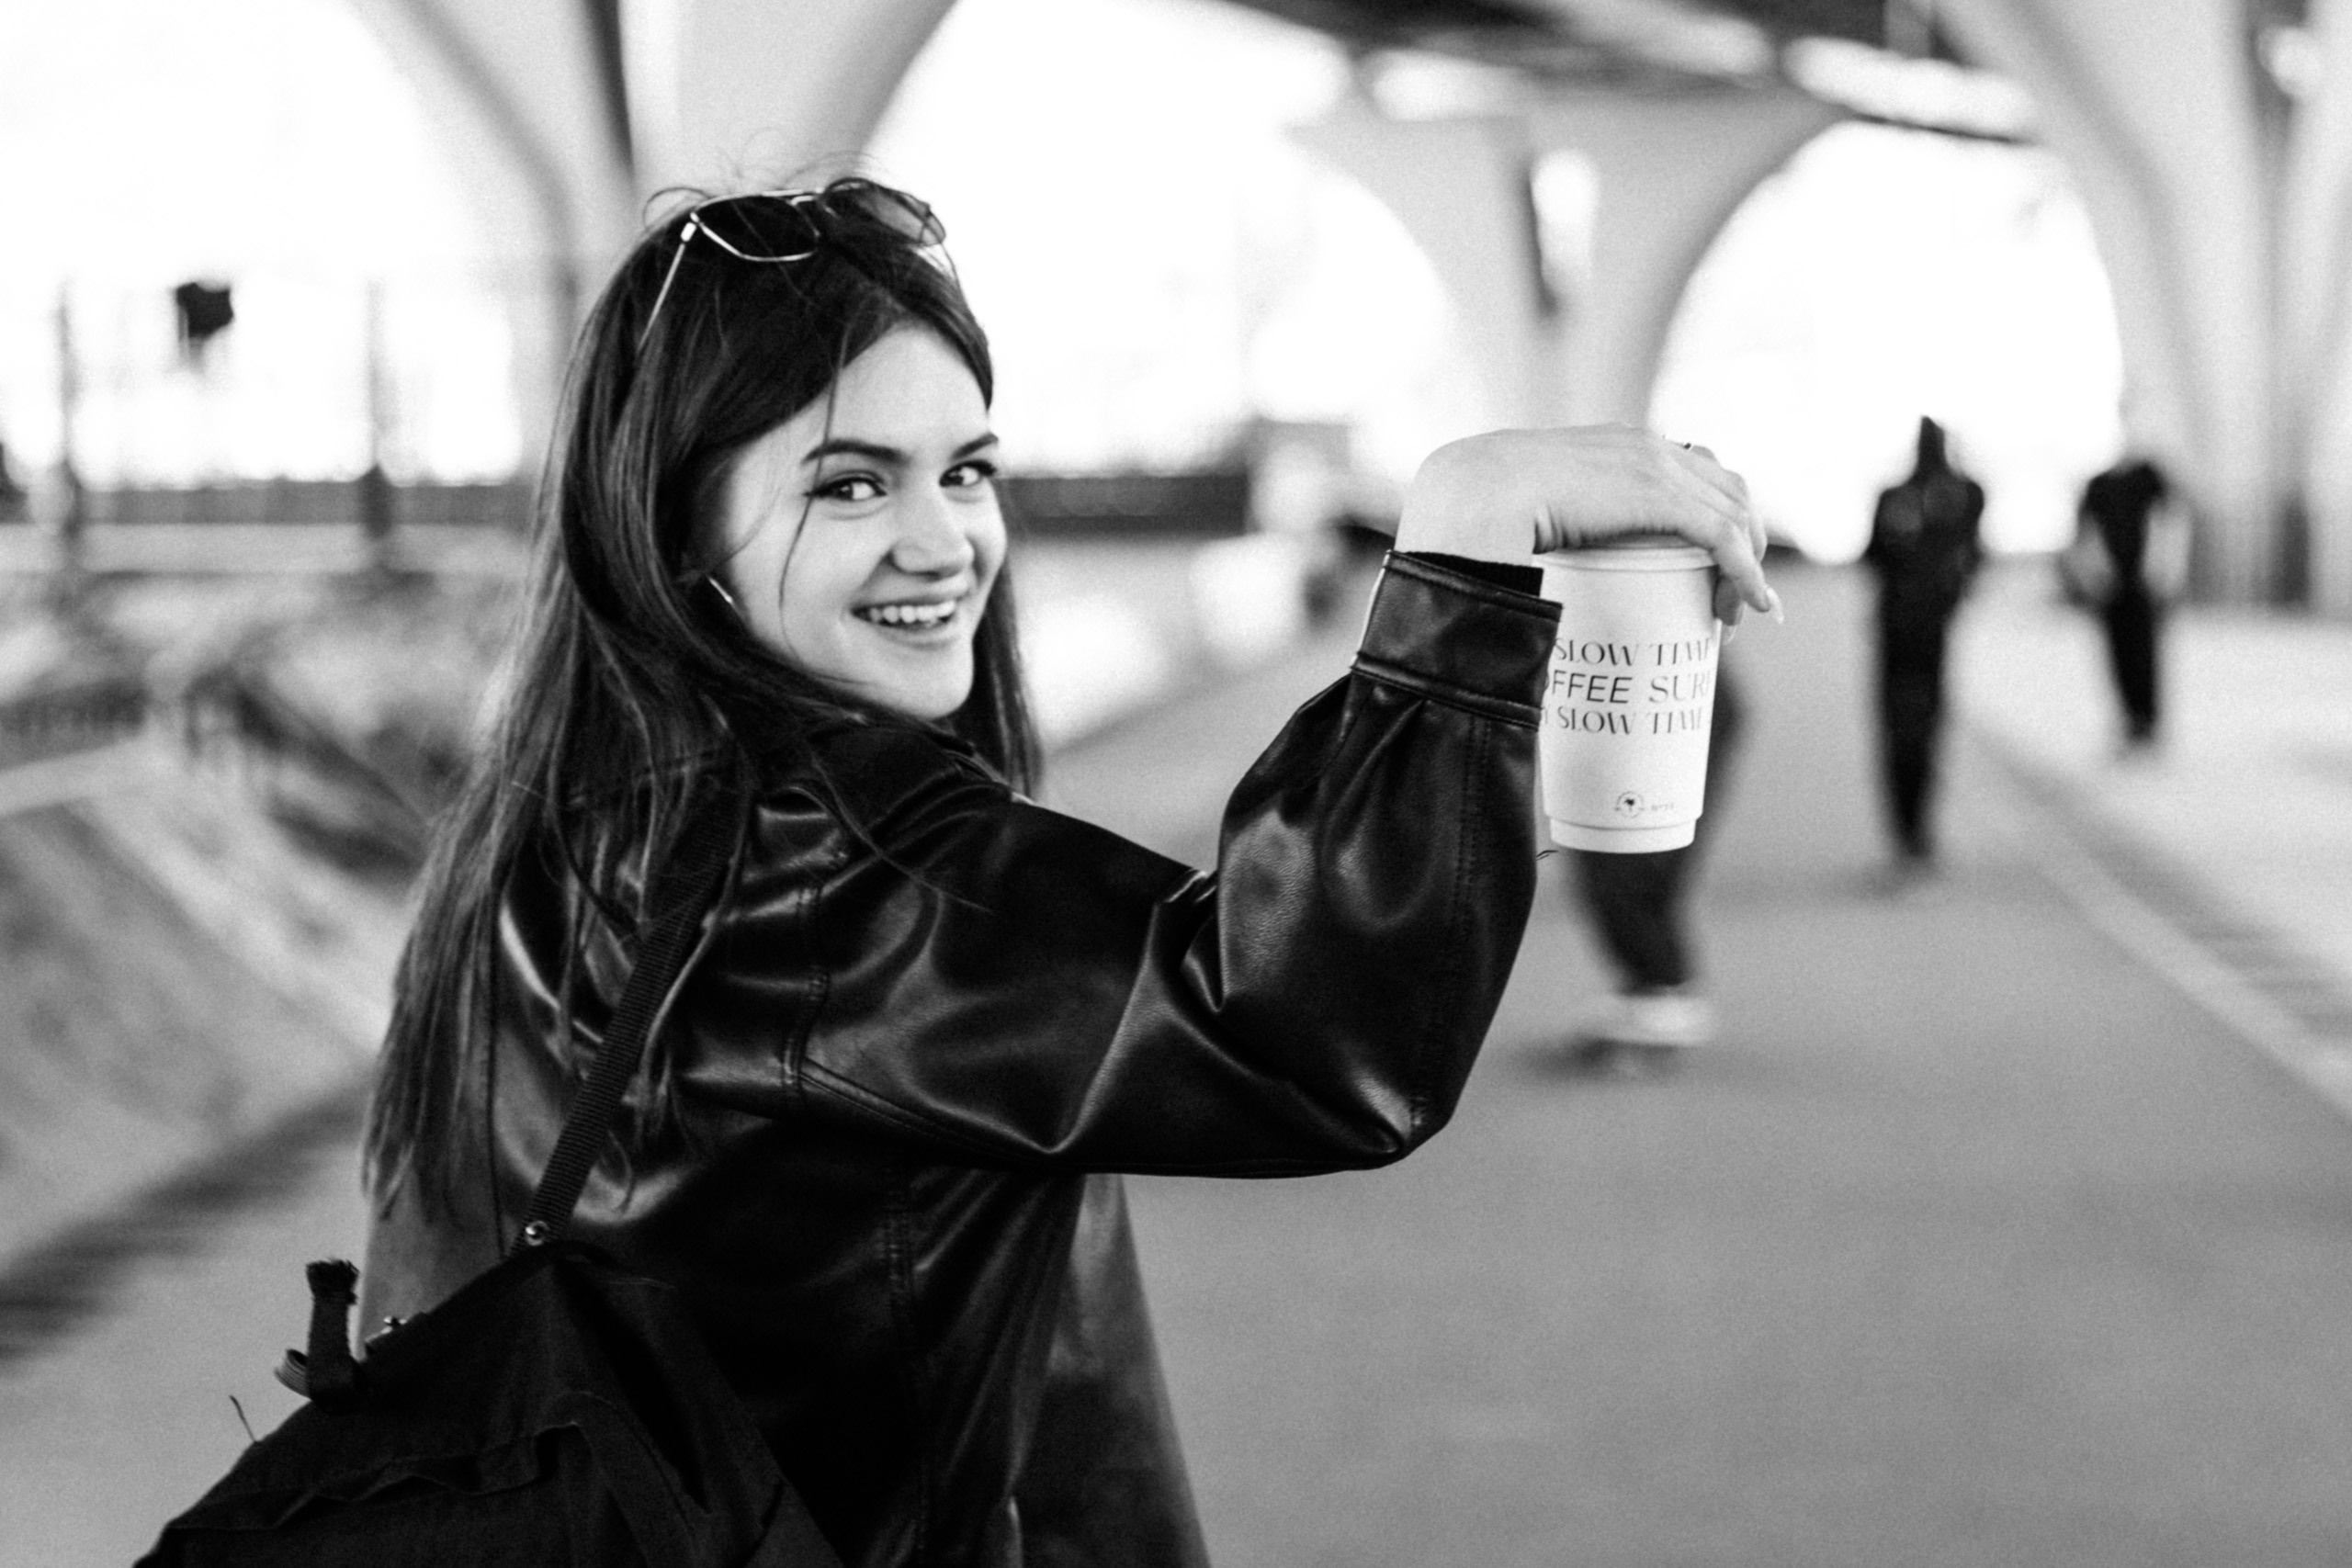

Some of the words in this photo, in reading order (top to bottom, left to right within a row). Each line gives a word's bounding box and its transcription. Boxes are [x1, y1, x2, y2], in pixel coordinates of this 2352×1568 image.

[1555, 638, 1639, 666] SLOW
[1547, 669, 1633, 704] FFEE
[1557, 705, 1636, 734] SLOW
